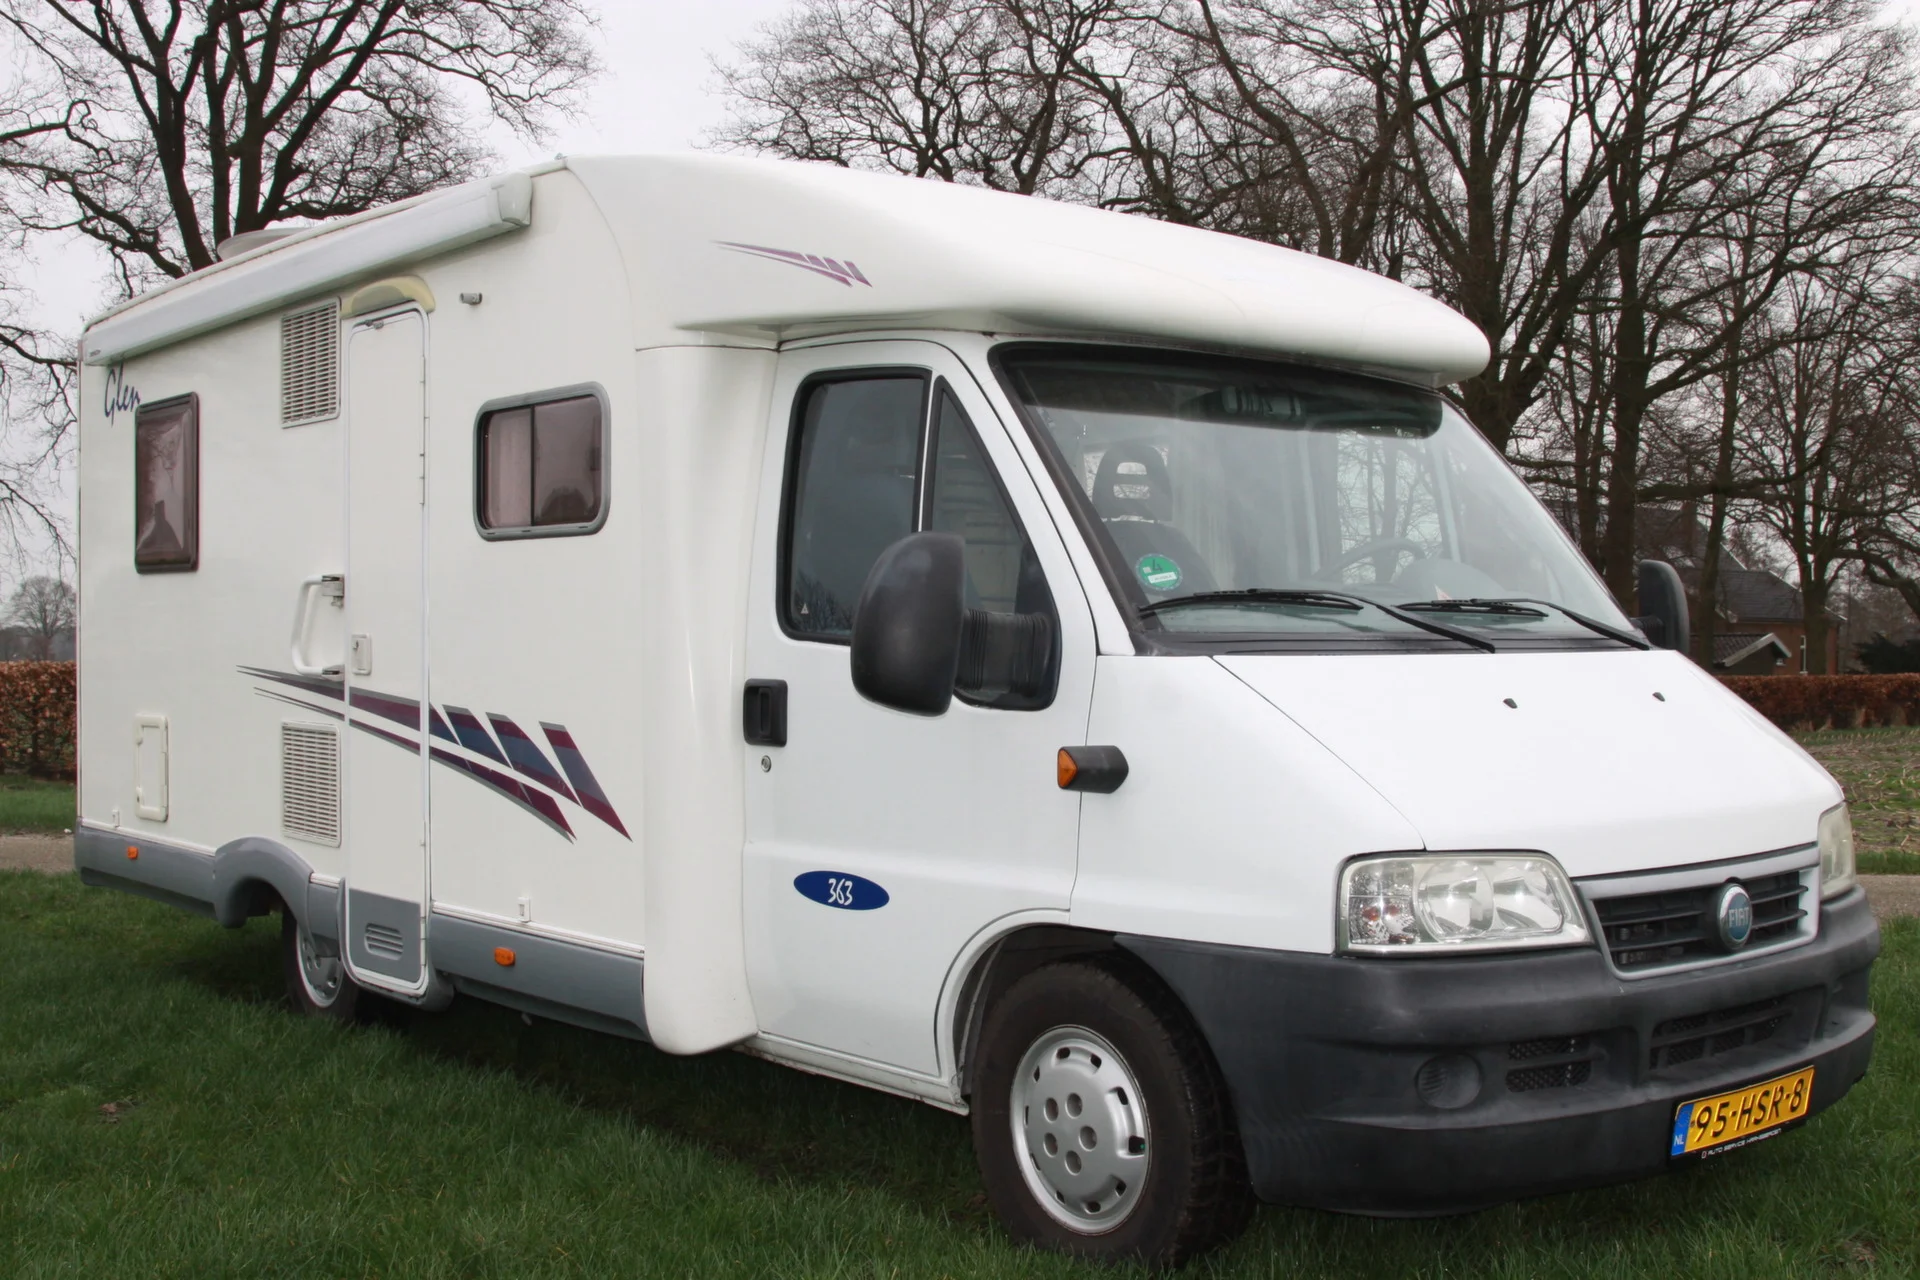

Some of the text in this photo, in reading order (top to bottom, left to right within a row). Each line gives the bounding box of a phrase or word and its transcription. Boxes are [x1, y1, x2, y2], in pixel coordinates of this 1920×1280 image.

[827, 877, 853, 906] 363
[1728, 906, 1750, 928] FIAT
[1694, 1077, 1805, 1143] 95-HSR-8
[1673, 1133, 1685, 1146] NL
[1707, 1146, 1724, 1156] AUTO
